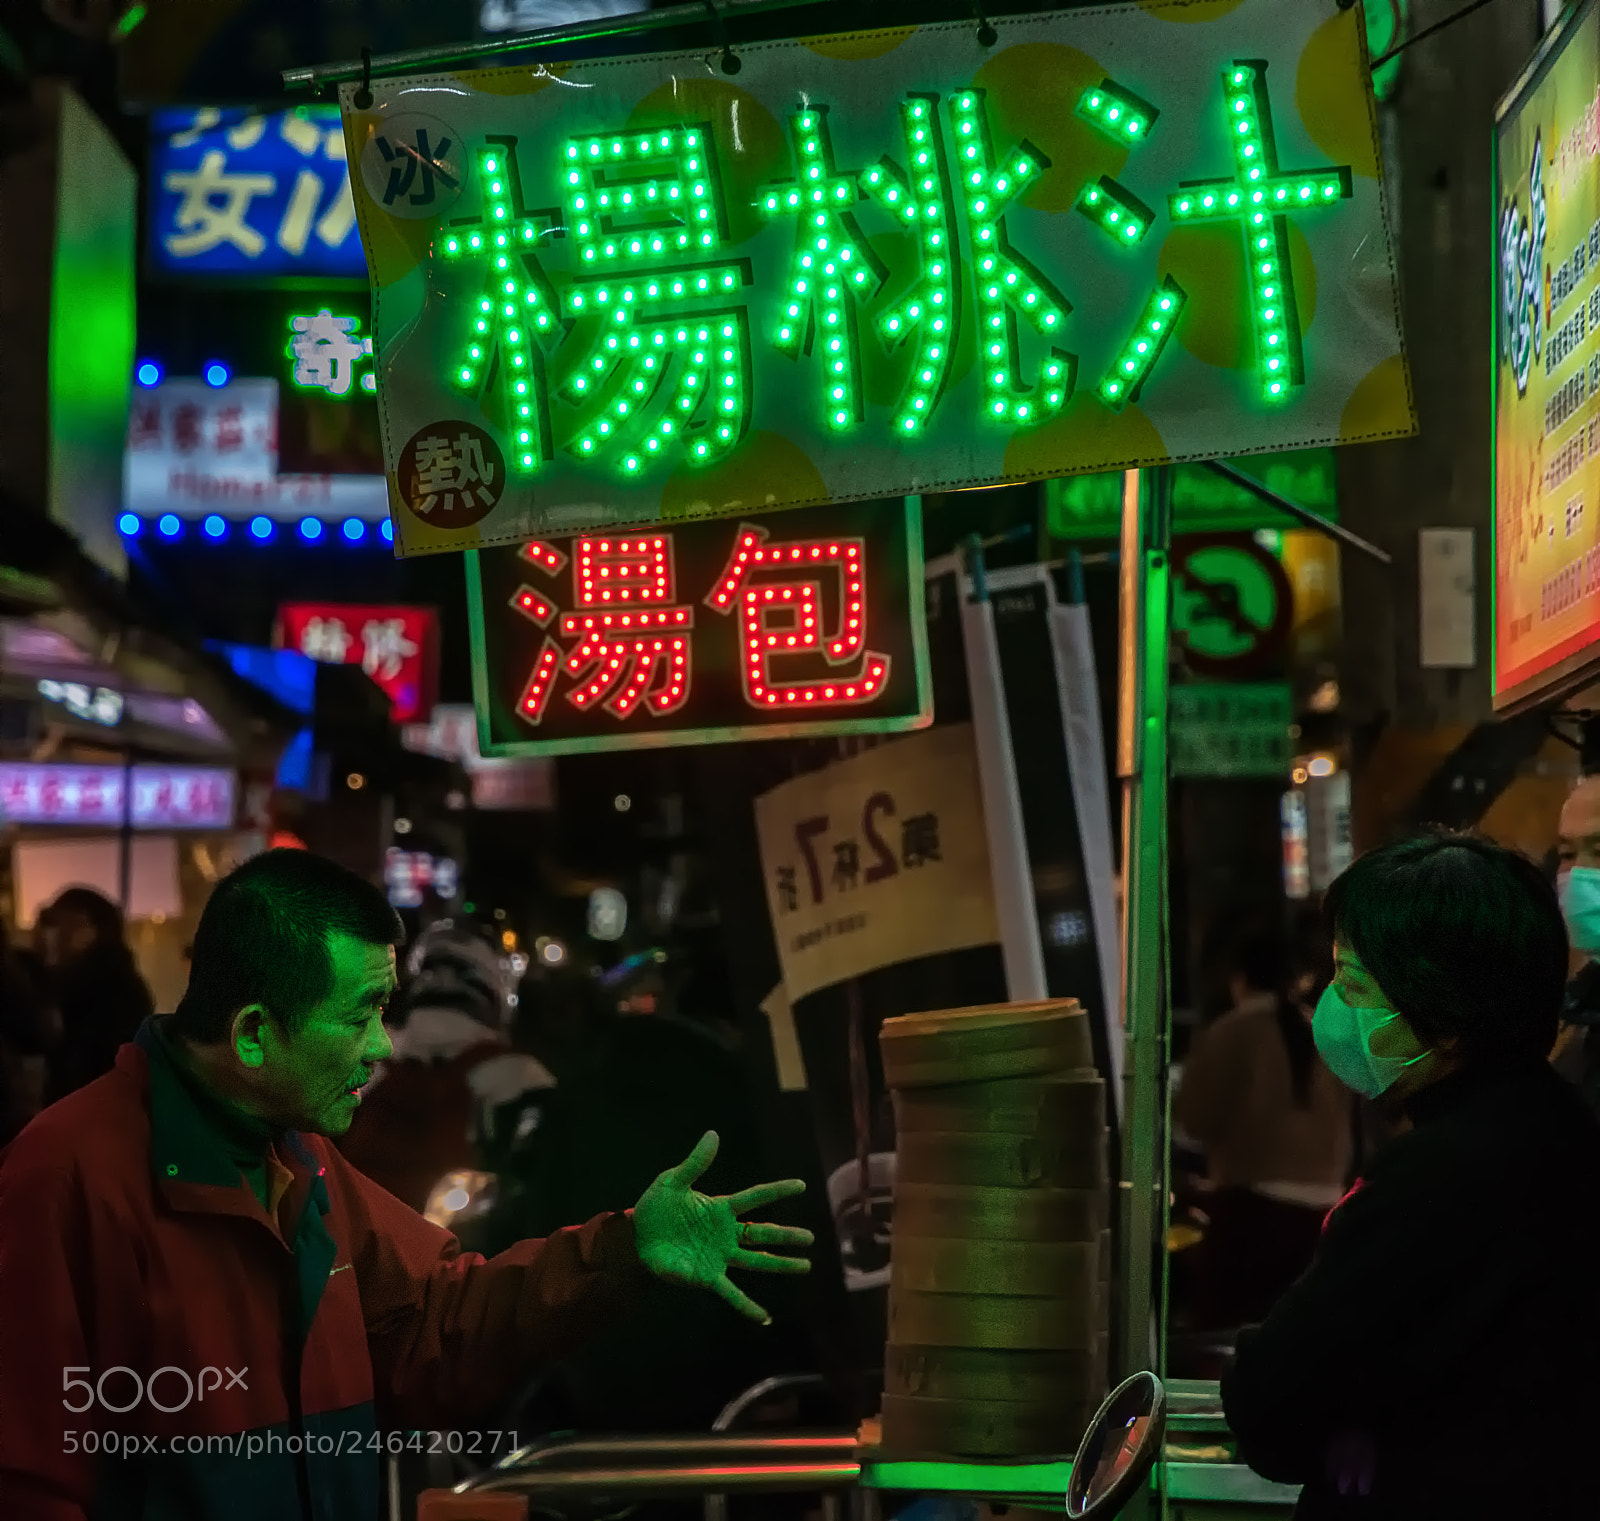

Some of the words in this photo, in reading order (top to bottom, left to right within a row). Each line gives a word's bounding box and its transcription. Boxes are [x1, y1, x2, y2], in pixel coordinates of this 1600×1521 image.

[375, 128, 461, 207] 冰
[438, 60, 1352, 474] 楊桃汁
[415, 431, 496, 514] 熱
[509, 522, 892, 726] 湯包
